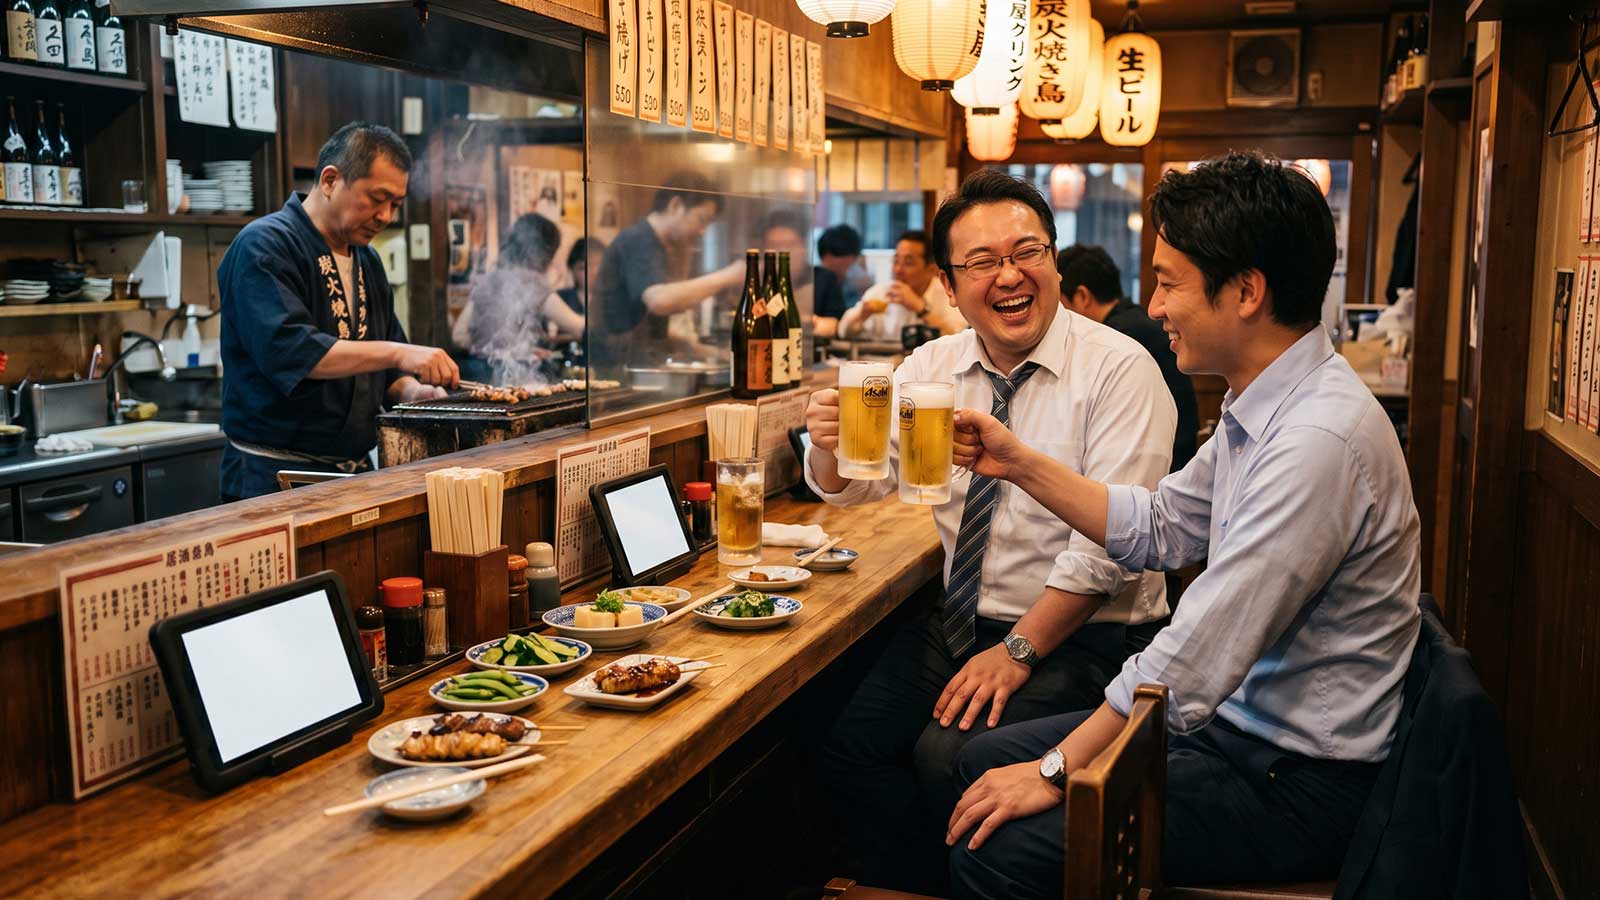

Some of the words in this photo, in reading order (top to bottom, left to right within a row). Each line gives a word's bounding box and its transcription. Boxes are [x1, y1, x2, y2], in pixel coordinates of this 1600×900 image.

[616, 84, 631, 103] 550
[1117, 47, 1145, 133] 生ビール
[865, 387, 888, 397] Asahi
